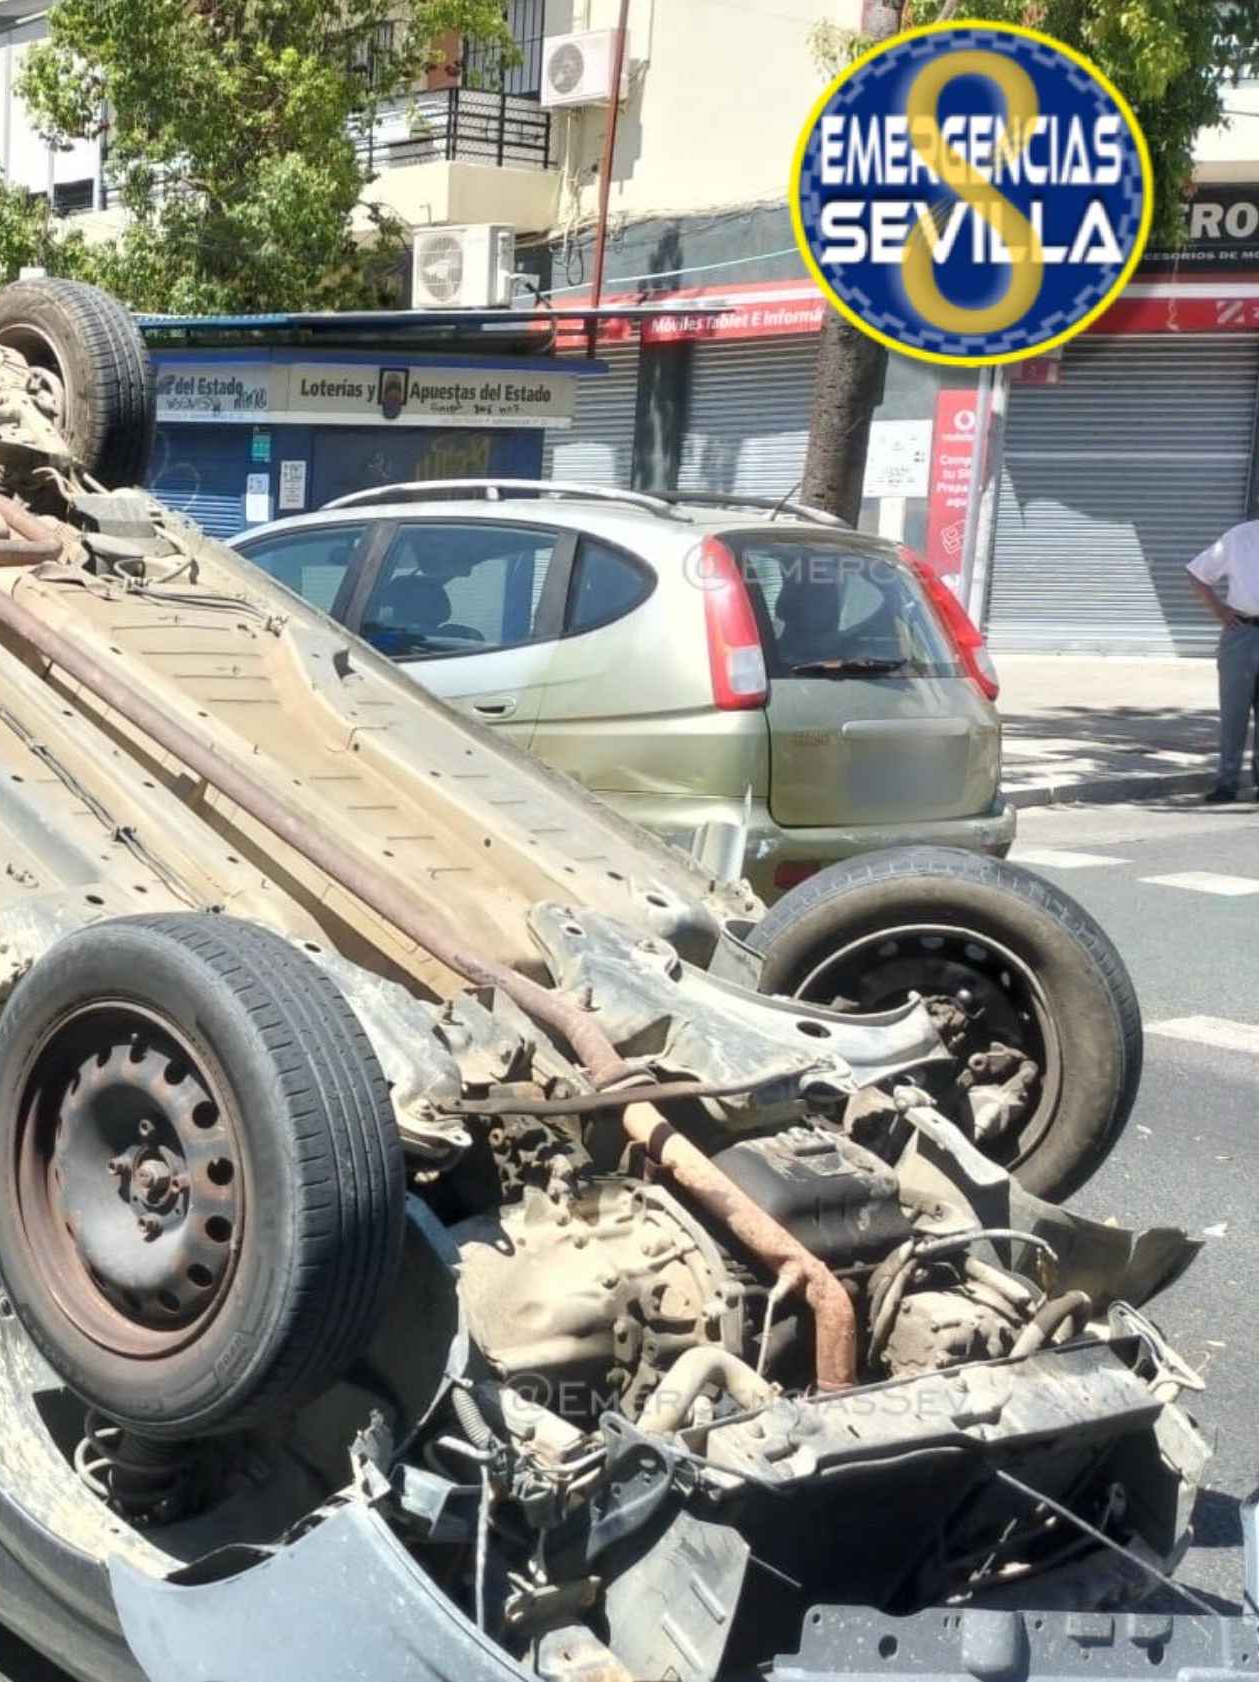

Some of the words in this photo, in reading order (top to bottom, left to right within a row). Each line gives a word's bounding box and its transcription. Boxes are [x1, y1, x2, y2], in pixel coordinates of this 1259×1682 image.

[1179, 202, 1259, 239] RO
[1219, 251, 1238, 260] DE
[174, 376, 195, 395] del
[197, 376, 243, 395] Estado
[300, 378, 363, 399] Loterías
[367, 385, 376, 402] y
[410, 382, 476, 402] Apuestas
[479, 383, 502, 400] del
[505, 384, 552, 403] Estado
